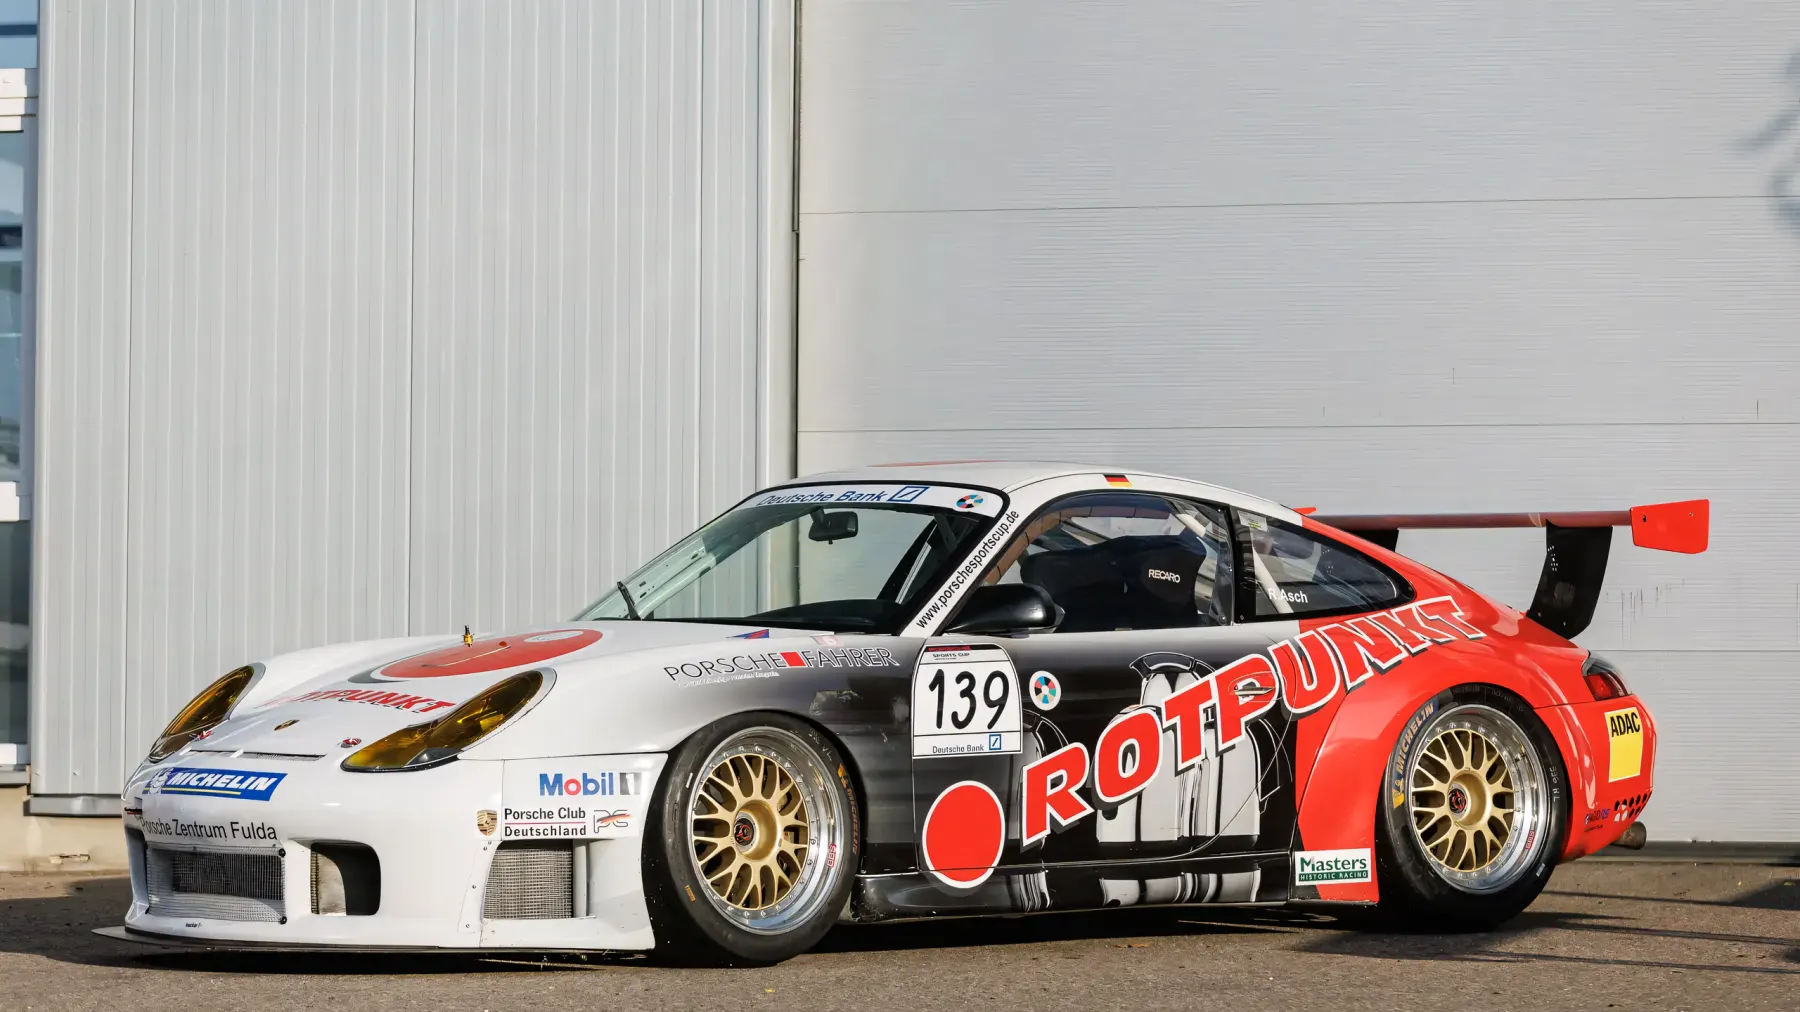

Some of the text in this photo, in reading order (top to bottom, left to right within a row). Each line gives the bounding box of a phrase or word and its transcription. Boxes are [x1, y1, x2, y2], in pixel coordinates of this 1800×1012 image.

[756, 490, 888, 506] Deutsche Bank
[916, 510, 1019, 628] www.porschesportscup.de
[1148, 569, 1181, 583] RECARO
[663, 652, 784, 681] PORSCHE
[800, 647, 900, 667] FAHRER
[929, 668, 1010, 730] 139
[1022, 595, 1487, 848] ROTPUNKT
[1610, 712, 1640, 738] ADAC
[932, 744, 984, 754] Deutsche Bank
[1396, 703, 1434, 775] MICHELIN
[166, 772, 278, 791] MICHELIN
[539, 773, 614, 796] Mobil
[504, 807, 586, 820] Porsche Club
[139, 816, 277, 840] Porsche Zentrum Fulda
[504, 825, 587, 837] Deutschland
[1300, 857, 1367, 872] Masters
[1339, 871, 1367, 879] RACING
